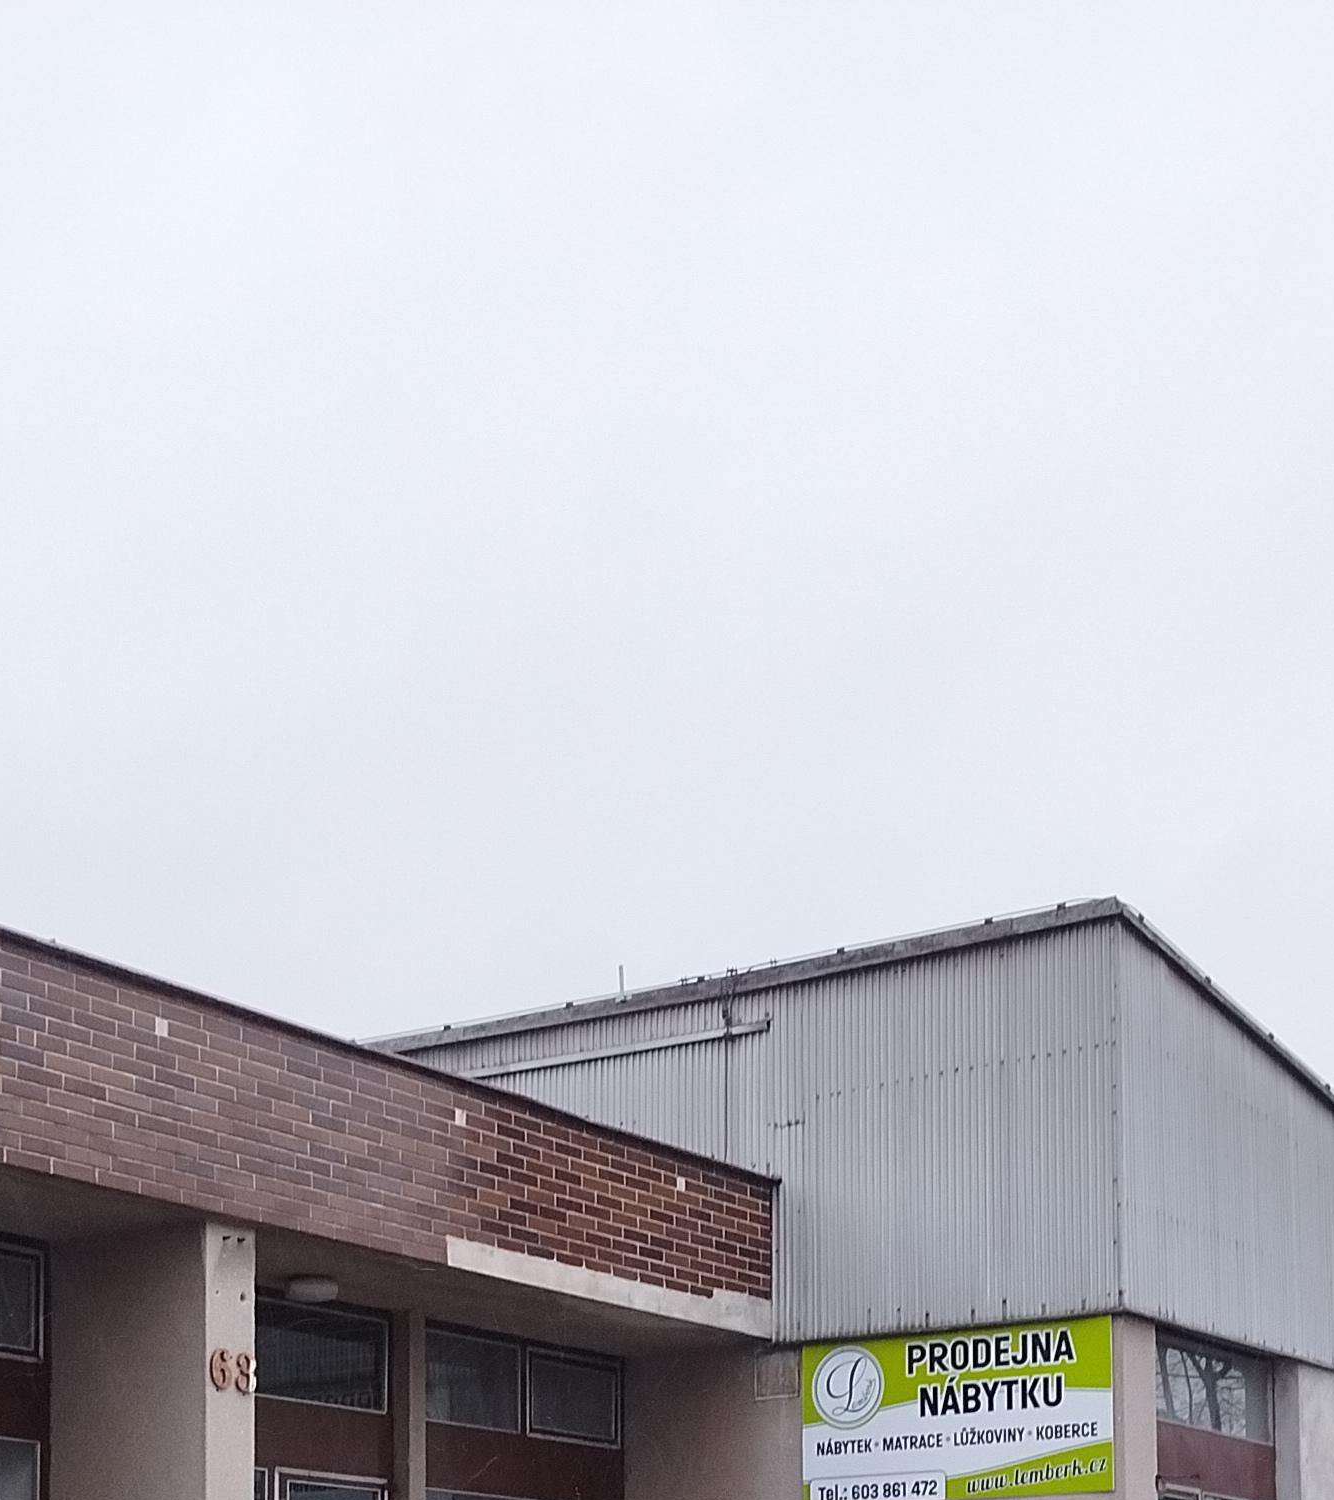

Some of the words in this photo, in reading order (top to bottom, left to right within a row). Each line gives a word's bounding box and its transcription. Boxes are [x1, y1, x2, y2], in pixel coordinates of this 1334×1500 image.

[907, 1329, 1075, 1375] PRODEJNA
[919, 1375, 1063, 1417] NÁBYTKU
[816, 1438, 872, 1456] NÁBYTEK
[882, 1433, 943, 1451] MATRACE
[953, 1426, 1025, 1446] LŮŽKOVINY
[1036, 1421, 1098, 1440] KOBERCE
[851, 1483, 879, 1500] 603
[882, 1481, 907, 1498] 861
[911, 1480, 938, 1496] 472
[967, 1457, 1107, 1493] www.lemberk.cz
